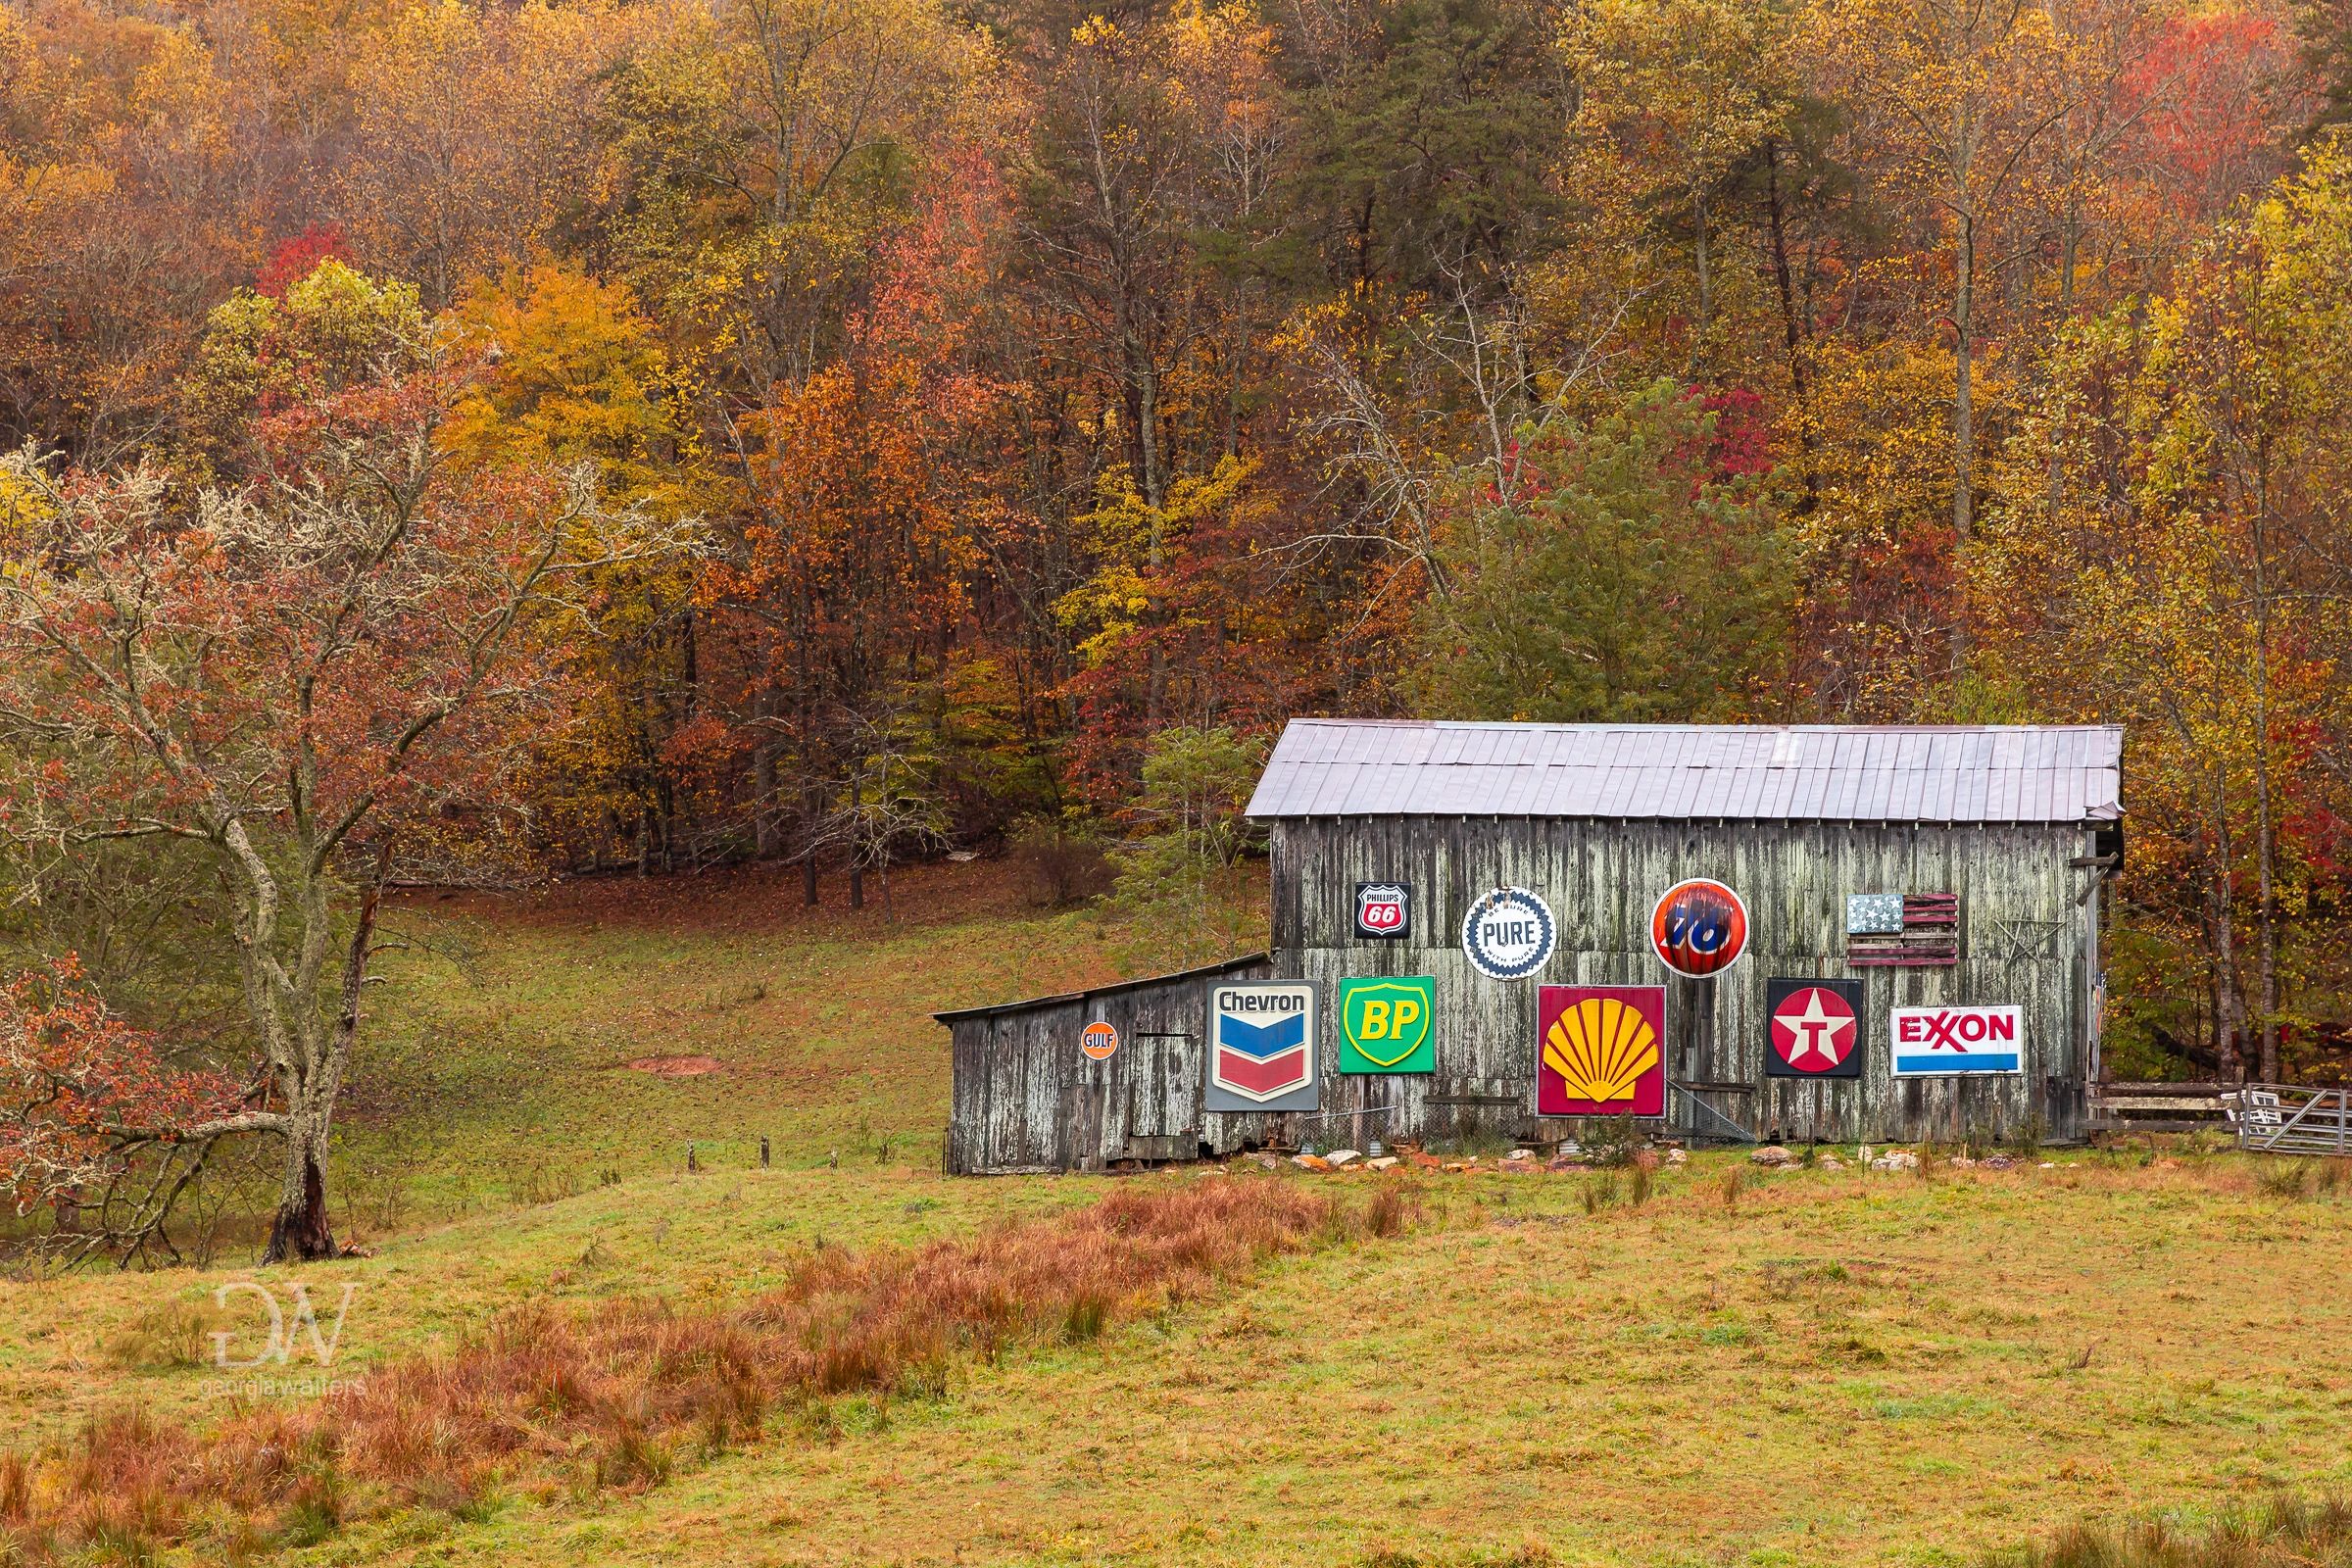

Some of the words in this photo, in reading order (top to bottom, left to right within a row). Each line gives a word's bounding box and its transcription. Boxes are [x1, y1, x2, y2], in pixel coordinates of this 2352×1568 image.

[1366, 894, 1399, 903] PHILLIPS
[1367, 906, 1396, 923] 66
[1483, 920, 1536, 948] PURE
[1219, 991, 1305, 1011] Chevron
[1358, 1000, 1420, 1040] BP
[1084, 1033, 1114, 1048] GULF
[1899, 1011, 2014, 1052] EXXON
